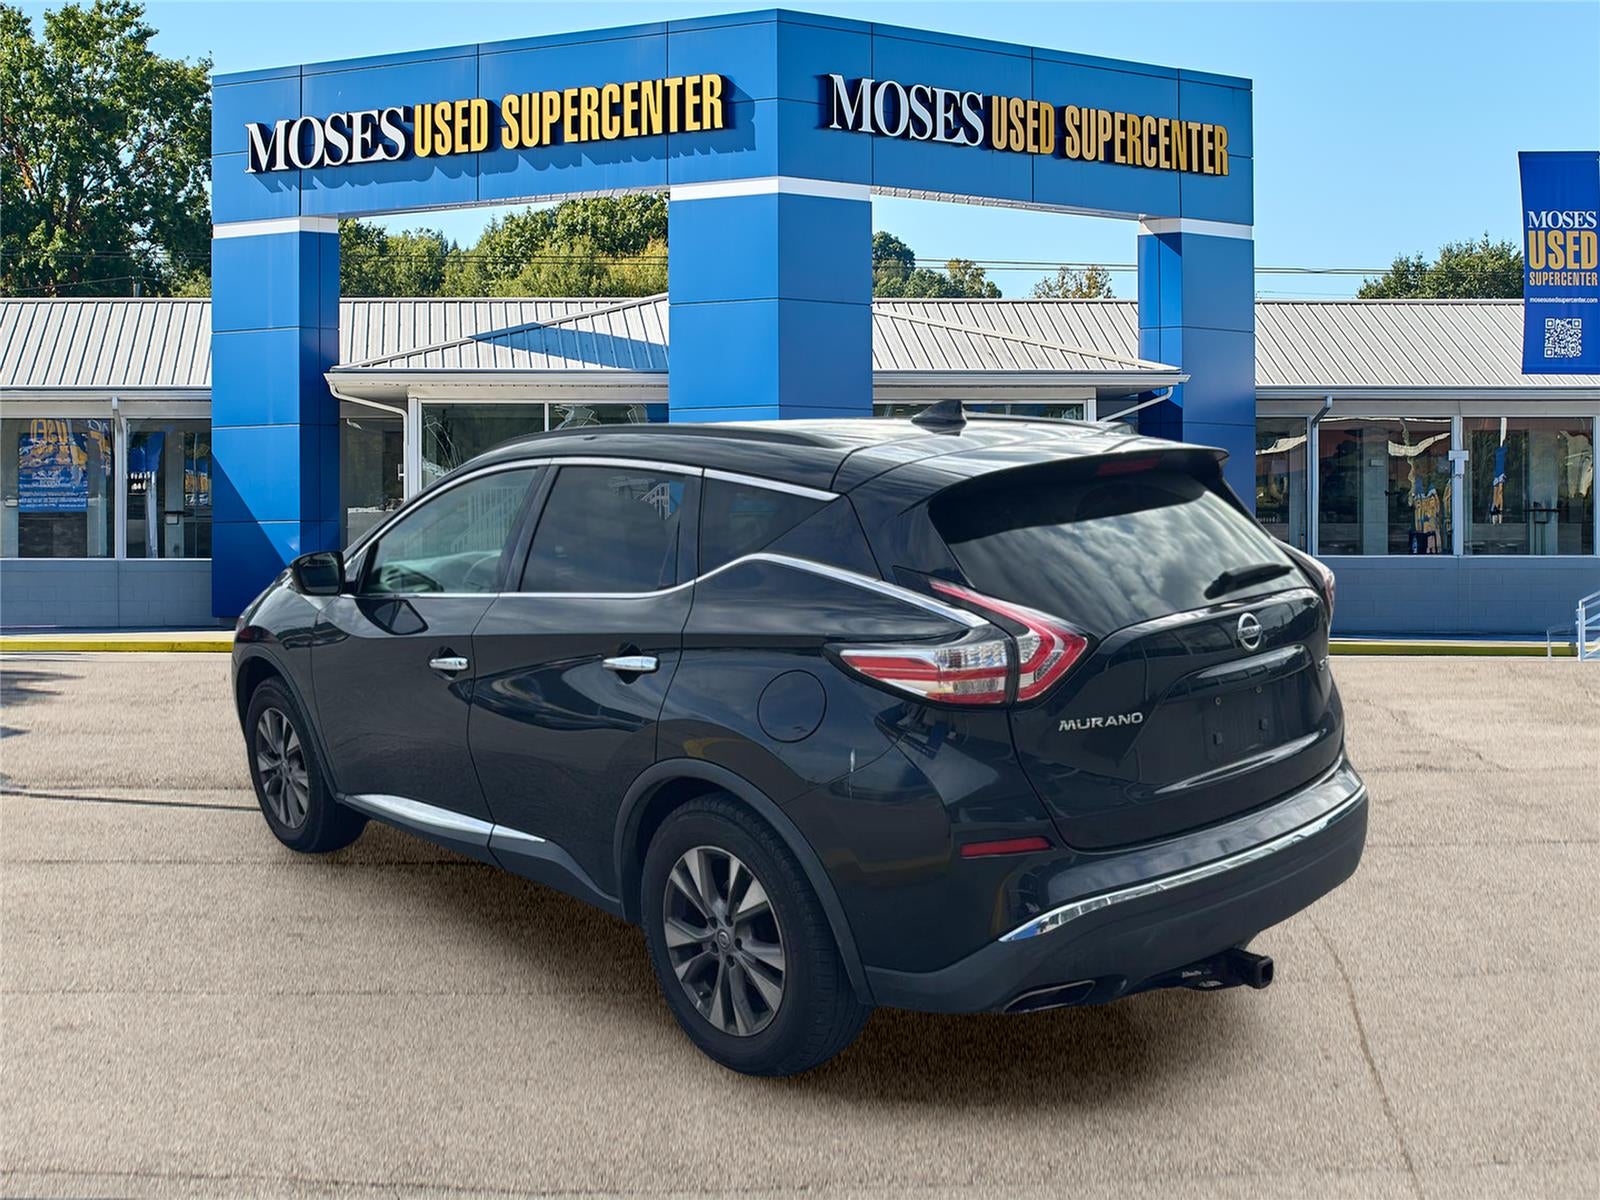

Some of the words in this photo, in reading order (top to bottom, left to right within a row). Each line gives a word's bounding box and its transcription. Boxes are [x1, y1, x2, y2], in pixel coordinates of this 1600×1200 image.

[245, 106, 407, 174] MOSES
[413, 98, 490, 158] USED
[500, 73, 725, 151] SUPERCENTER
[829, 73, 985, 147] MOSES
[991, 95, 1056, 155] USED
[1064, 104, 1230, 176] SUPERCENTER
[1528, 210, 1597, 229] MOSES
[1528, 230, 1598, 270] USED
[1529, 271, 1598, 286] SUPERCENTER
[1058, 711, 1144, 733] MURANO
